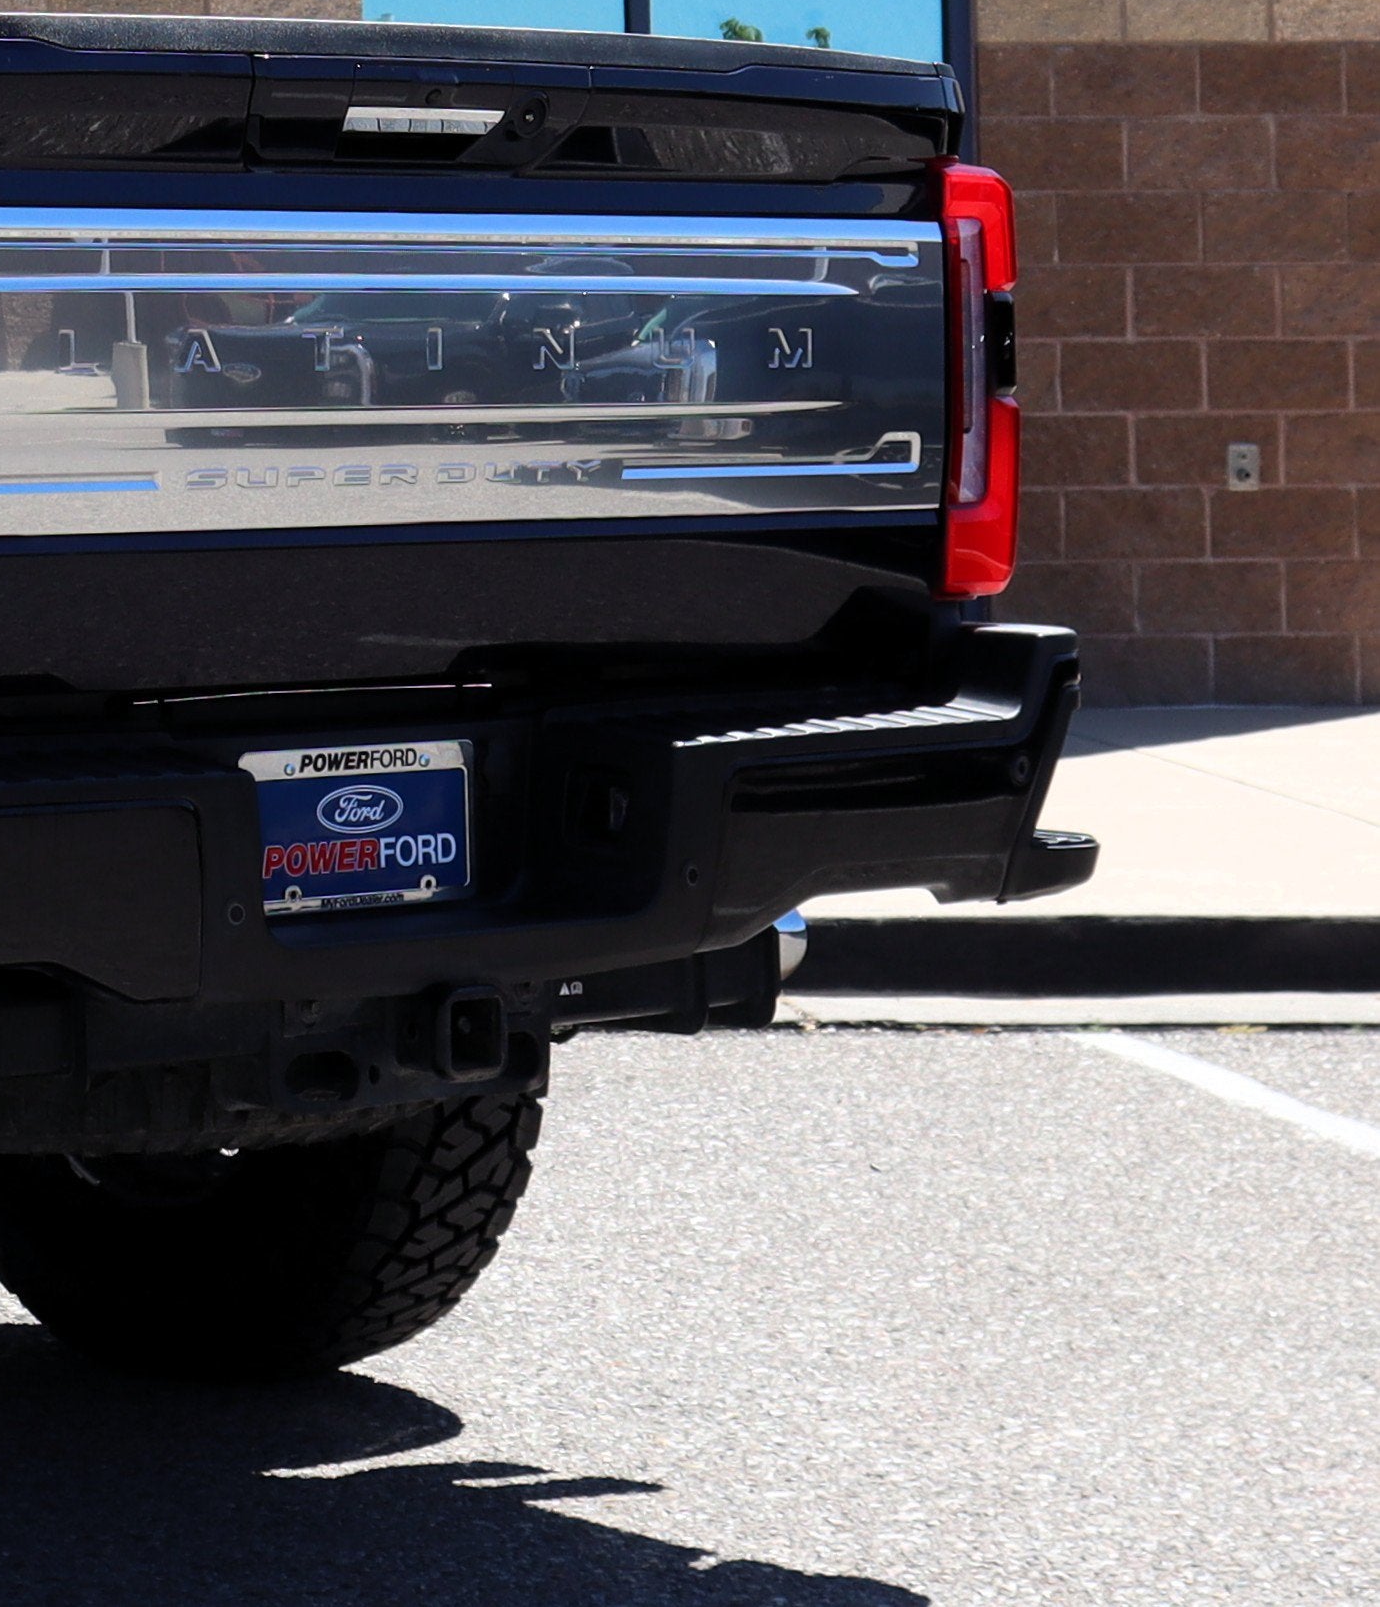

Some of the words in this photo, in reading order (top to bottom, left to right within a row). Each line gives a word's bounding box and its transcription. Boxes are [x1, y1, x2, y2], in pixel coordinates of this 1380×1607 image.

[184, 462, 420, 490] SUPER
[436, 459, 603, 485] DUTY
[299, 747, 418, 773] POWERFORD
[334, 793, 385, 823] Ford
[262, 832, 457, 879] POWERFORD
